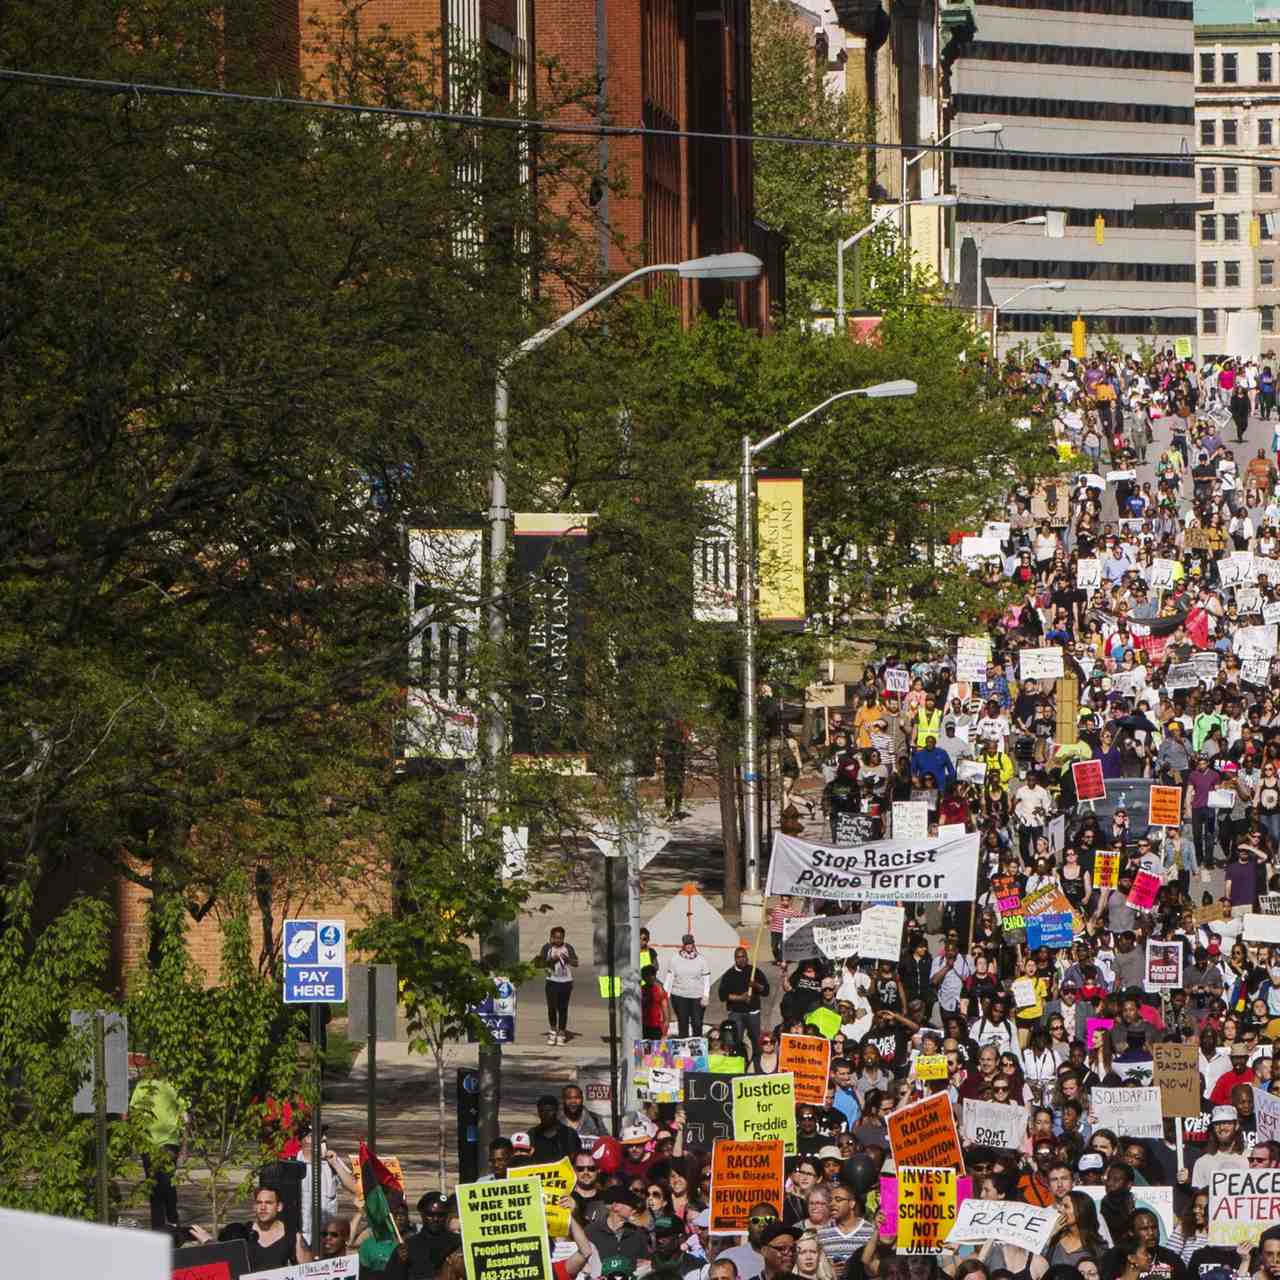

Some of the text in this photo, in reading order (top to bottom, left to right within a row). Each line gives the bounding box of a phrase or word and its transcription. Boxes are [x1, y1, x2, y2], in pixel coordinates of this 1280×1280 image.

[812, 849, 937, 870] Stop Racist
[795, 870, 945, 889] Police Terror
[323, 926, 337, 941] 4
[298, 970, 328, 983] PAY
[293, 984, 336, 998] HERE
[788, 1039, 823, 1052] Stand
[1156, 1050, 1182, 1060] END
[1156, 1061, 1196, 1072] RACISM
[737, 1081, 791, 1099] Justice
[1095, 1088, 1159, 1105] SOLIDARITY
[756, 1101, 774, 1112] for
[743, 1117, 788, 1132] Freddie
[900, 1113, 941, 1137] RACISM
[899, 1140, 956, 1167] REVOLUTION
[726, 1155, 770, 1169] RACISM
[727, 1170, 740, 1180] the
[902, 1169, 952, 1185] INVEST
[468, 1184, 530, 1199] A LIVABLE
[715, 1189, 780, 1202] REVOLUTION
[920, 1187, 933, 1200] IN
[468, 1196, 532, 1212] WAGE NOT
[722, 1204, 747, 1215] is the
[480, 1209, 523, 1223] POLICE
[899, 1204, 955, 1220] SCHOOLS
[480, 1222, 527, 1236] TERROR
[969, 1211, 1047, 1233] RACE
[912, 1222, 939, 1237] NOT
[474, 1243, 510, 1257] Peoples
[906, 1240, 944, 1255] JAILS
[486, 1254, 530, 1268] Assembly
